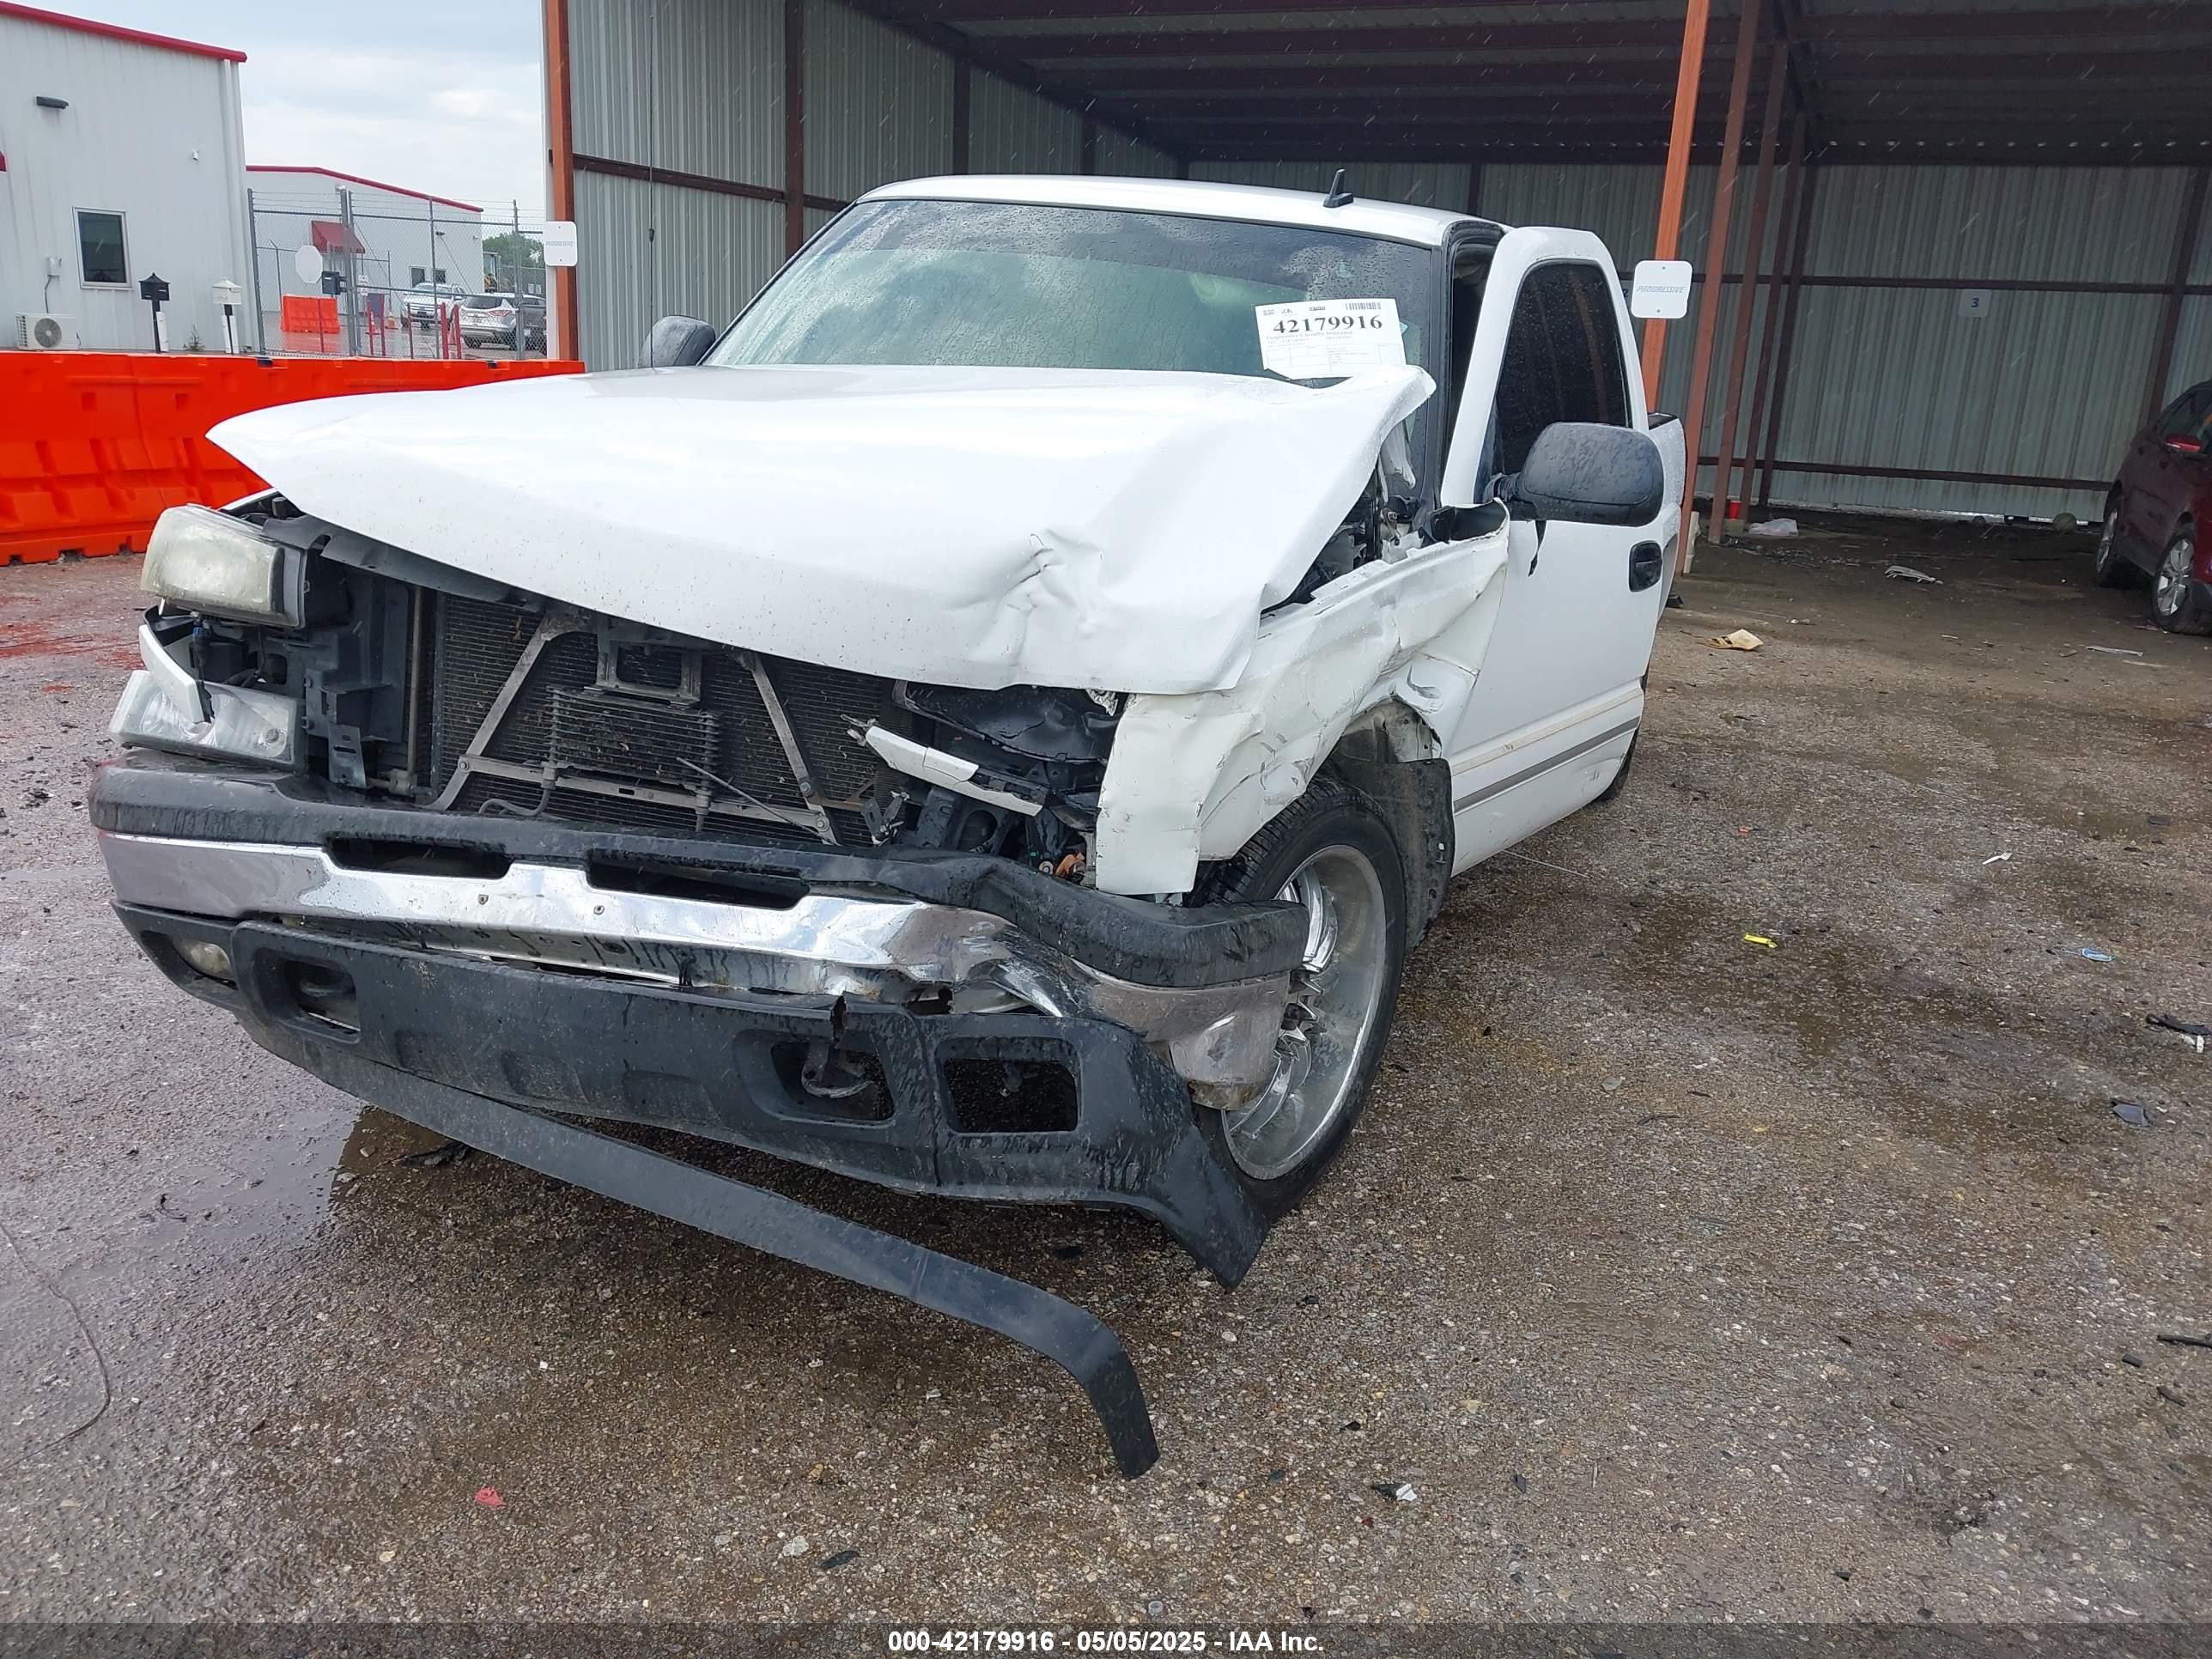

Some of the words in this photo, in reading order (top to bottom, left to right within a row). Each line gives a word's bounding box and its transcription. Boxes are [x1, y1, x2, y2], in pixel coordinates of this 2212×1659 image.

[1622, 289, 1629, 298] 2
[1637, 285, 1687, 294] PROGRESSIVE
[1971, 297, 1979, 308] 3
[1273, 314, 1382, 334] 42179916
